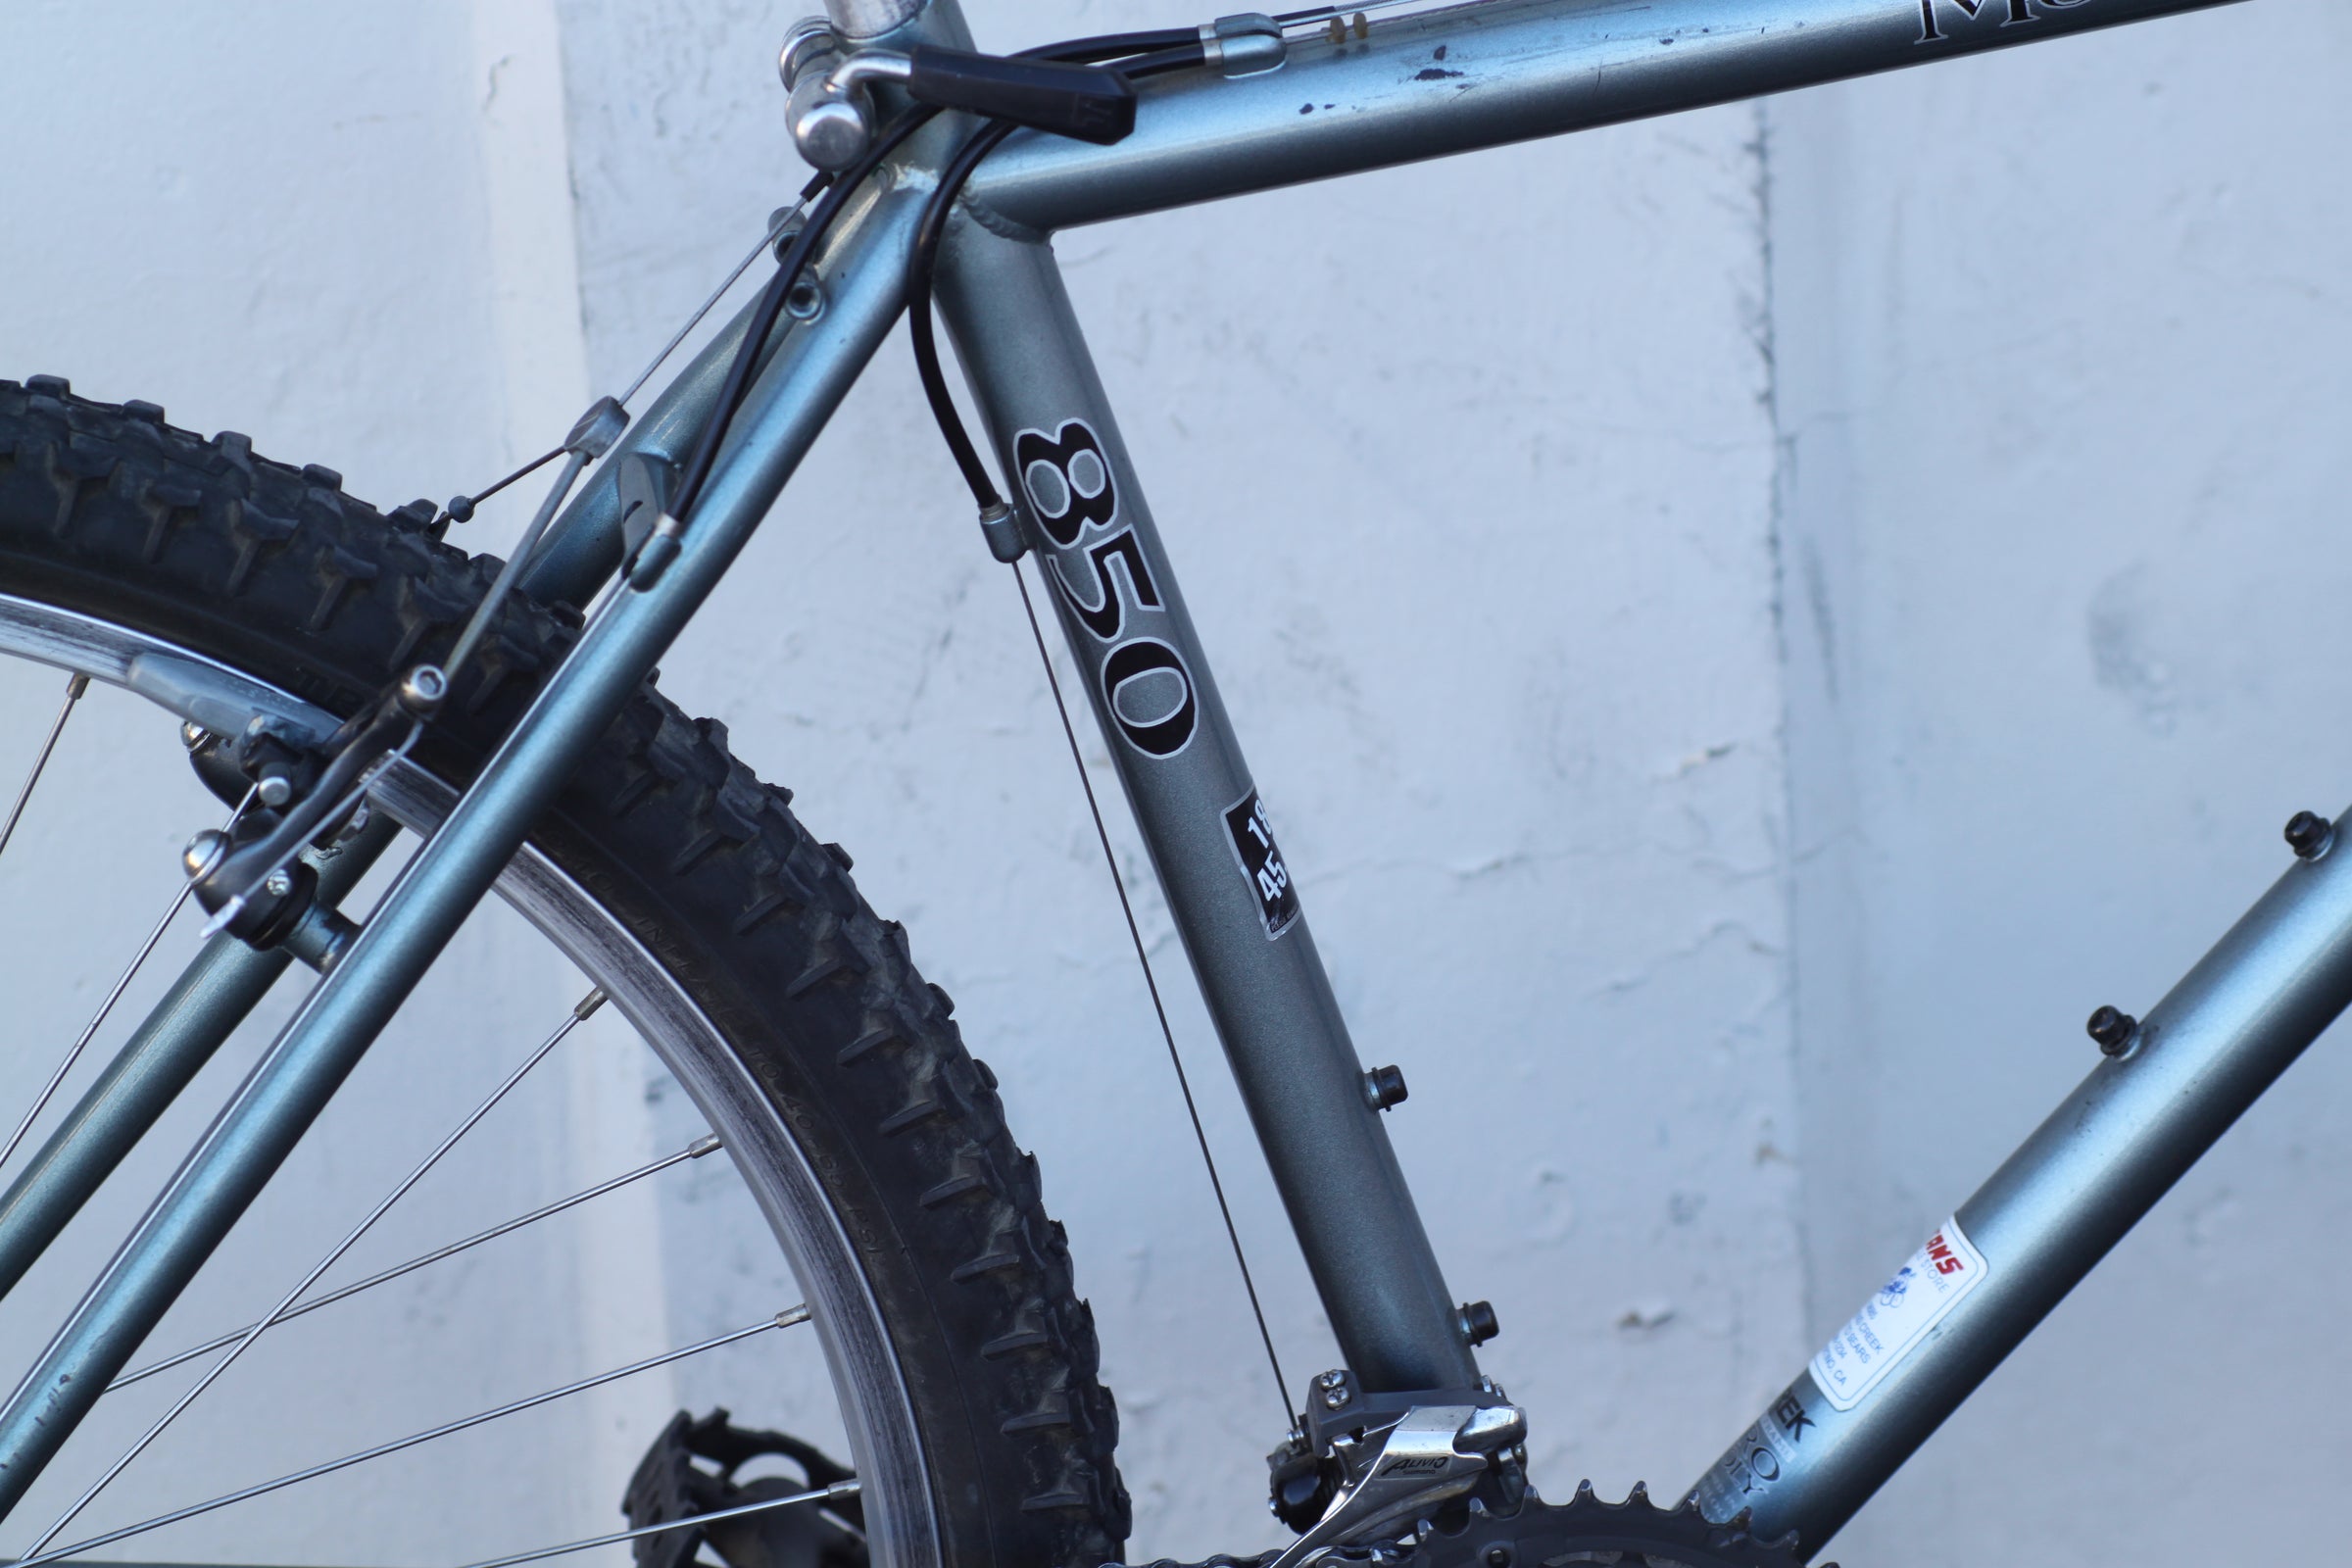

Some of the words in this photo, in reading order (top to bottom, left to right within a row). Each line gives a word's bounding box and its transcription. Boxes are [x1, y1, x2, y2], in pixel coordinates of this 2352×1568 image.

[1013, 418, 1199, 760] 850
[1921, 1257, 1950, 1295] STORE
[1858, 1321, 1885, 1354] CREEK
[1834, 1368, 1847, 1386] CA
